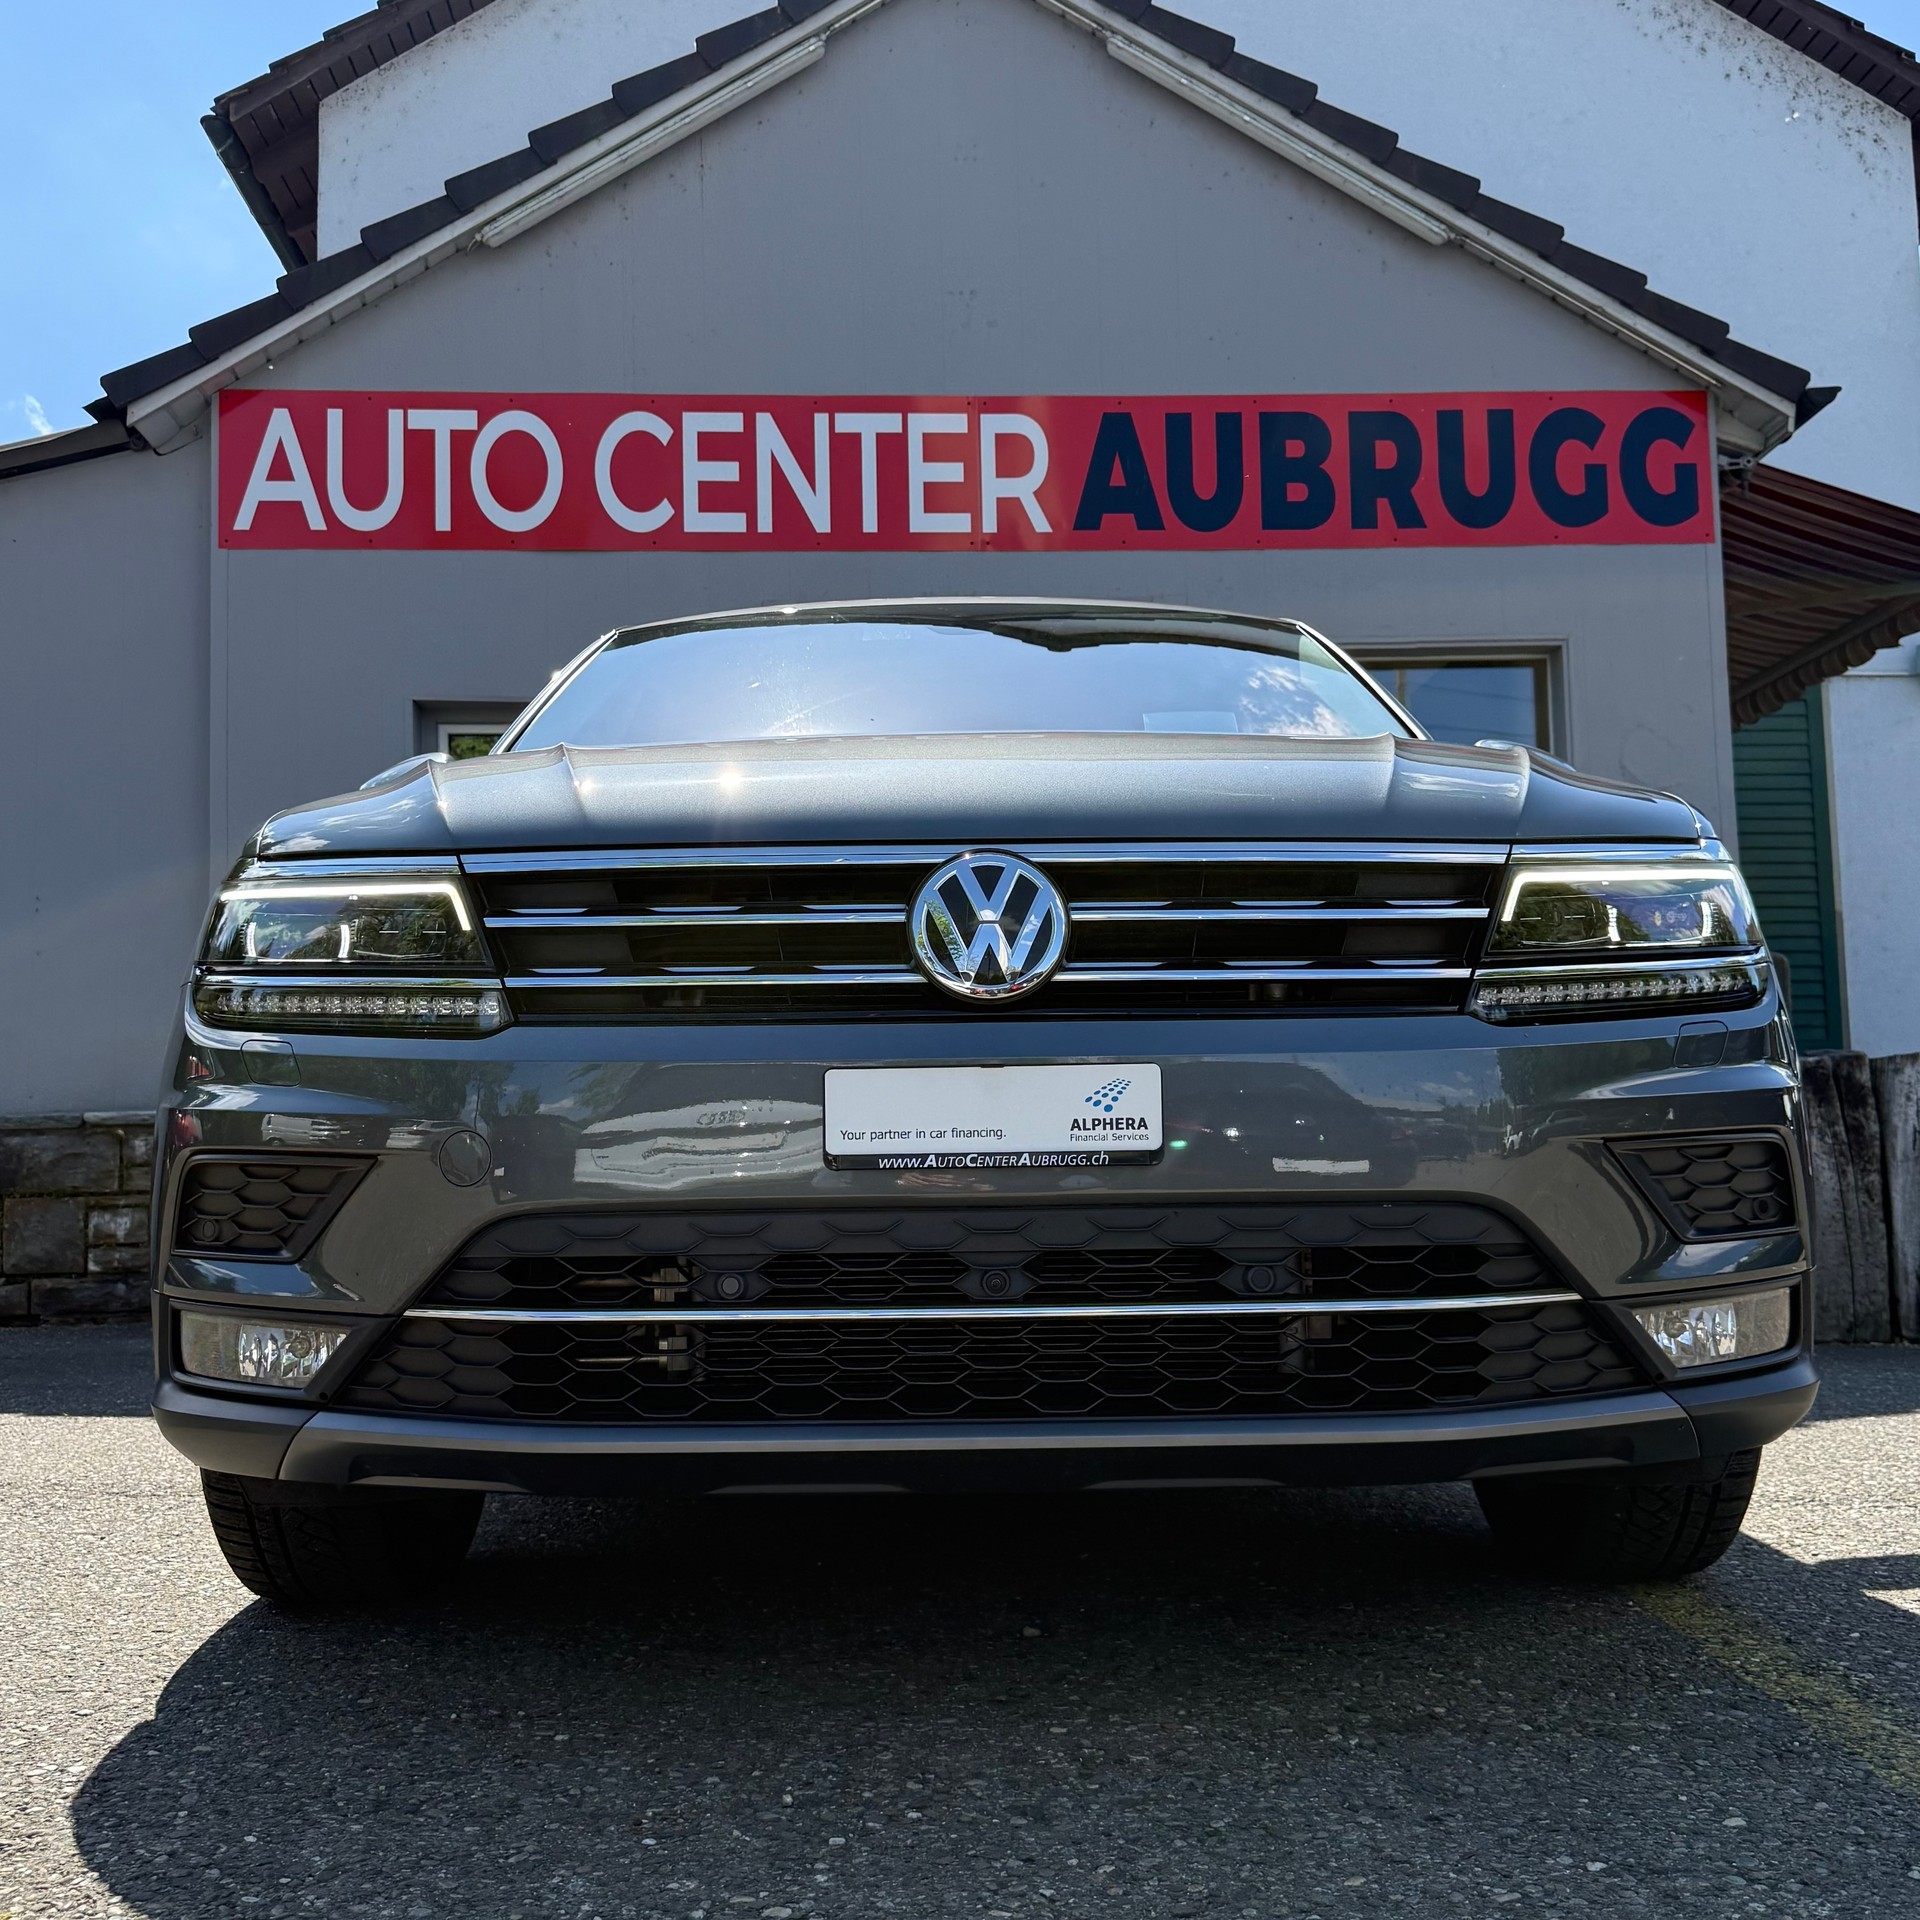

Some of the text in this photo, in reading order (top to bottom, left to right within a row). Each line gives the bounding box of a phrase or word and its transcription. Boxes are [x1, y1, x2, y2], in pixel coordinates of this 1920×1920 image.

[233, 406, 1700, 535] AUTO CENTER AUBRUGG
[1070, 1117, 1149, 1132] ALPHERA
[840, 1127, 1007, 1142] Your partner in car financing.
[1070, 1132, 1149, 1142] Financial Services
